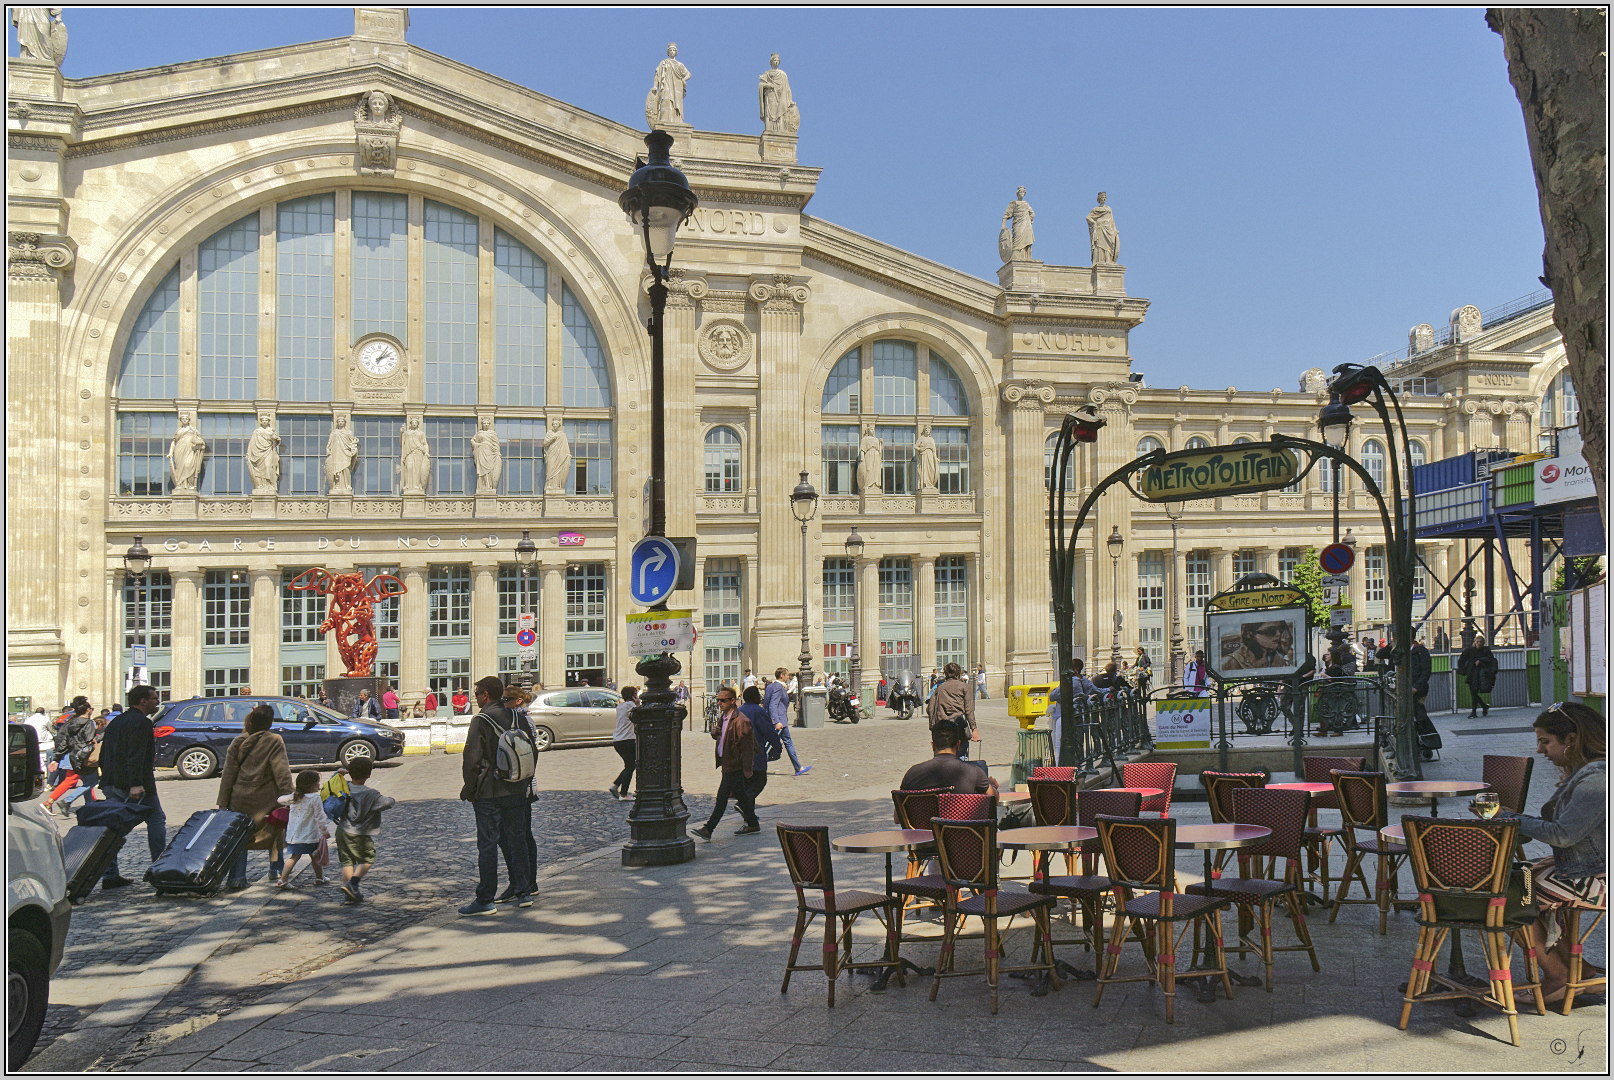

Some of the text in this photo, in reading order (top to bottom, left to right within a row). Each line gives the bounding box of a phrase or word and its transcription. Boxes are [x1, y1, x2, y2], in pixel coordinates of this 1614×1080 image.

[361, 14, 396, 29] PARIS
[688, 209, 766, 236] NORD
[1037, 329, 1102, 352] NORD
[1484, 373, 1514, 387] NORD
[1147, 451, 1292, 492] METROPOLITAIN
[164, 534, 499, 552] GARE DU NORD
[560, 535, 585, 544] SNCF
[1229, 596, 1250, 607] GARE
[1262, 593, 1285, 604] NORD
